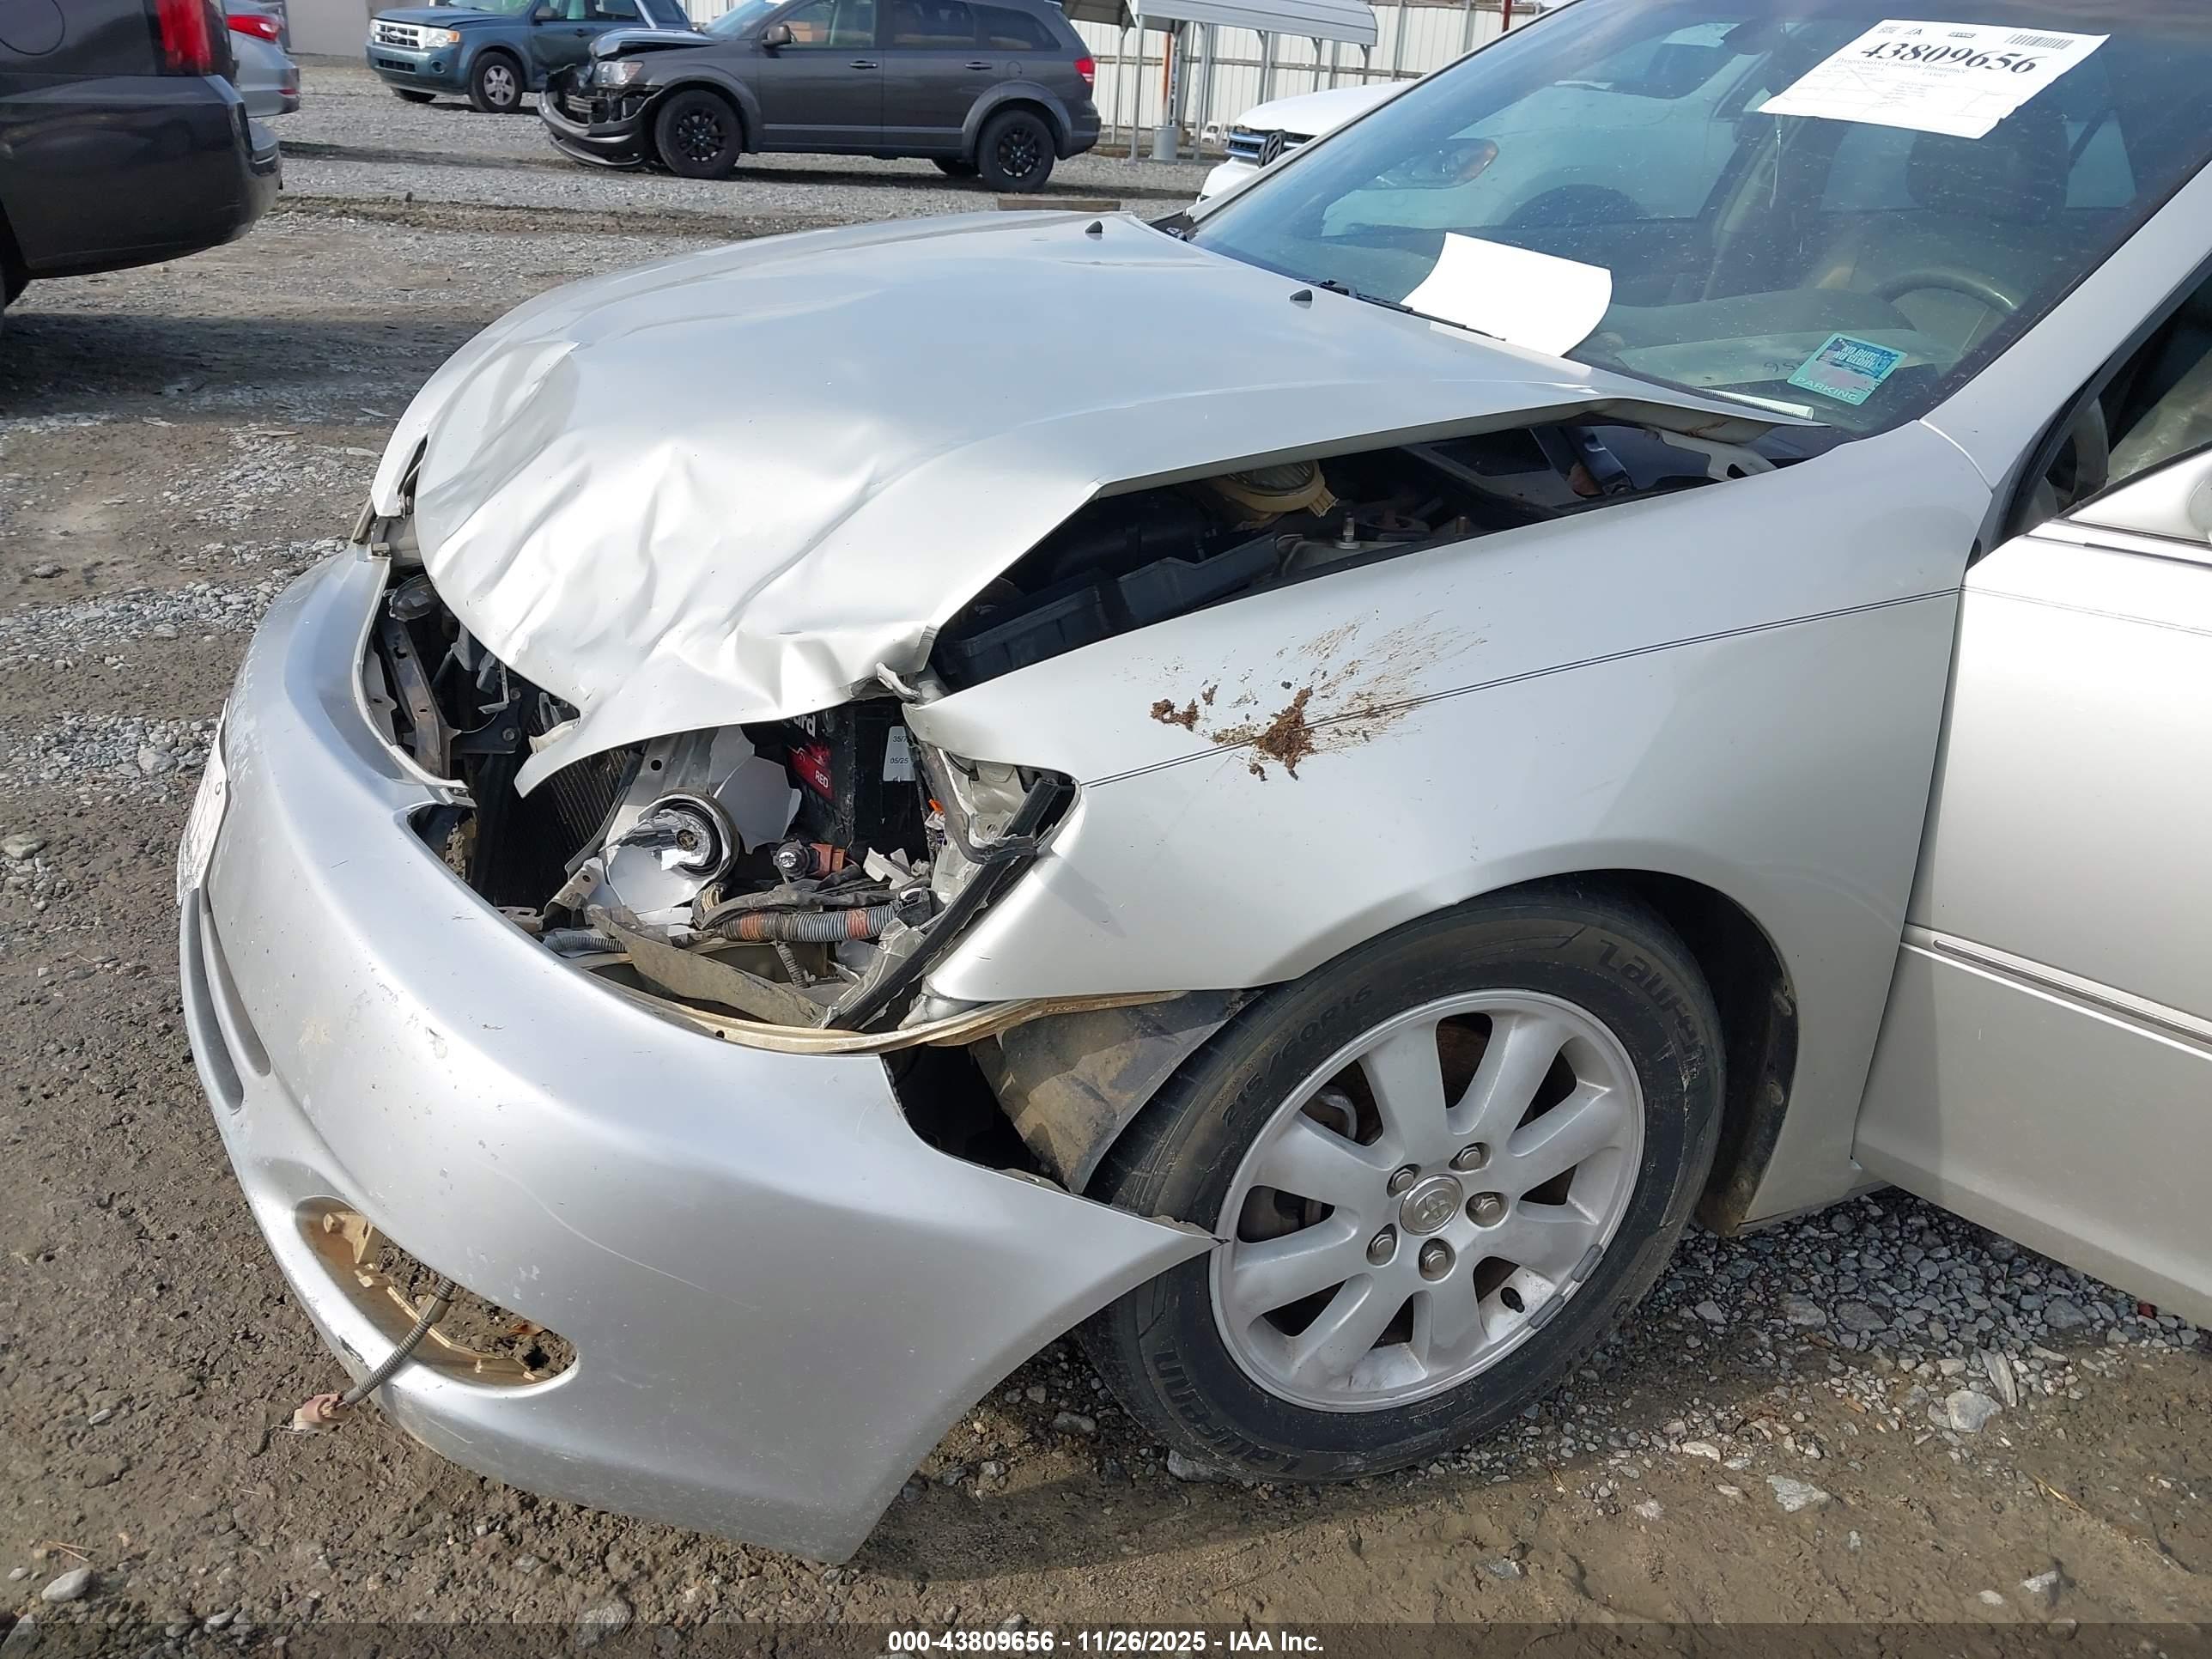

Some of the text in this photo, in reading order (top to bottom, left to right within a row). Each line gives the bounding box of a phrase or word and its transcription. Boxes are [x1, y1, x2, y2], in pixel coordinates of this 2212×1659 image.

[1860, 40, 2049, 75] 43809656
[1832, 350, 1848, 361] NO
[1794, 376, 1858, 402] PARKING
